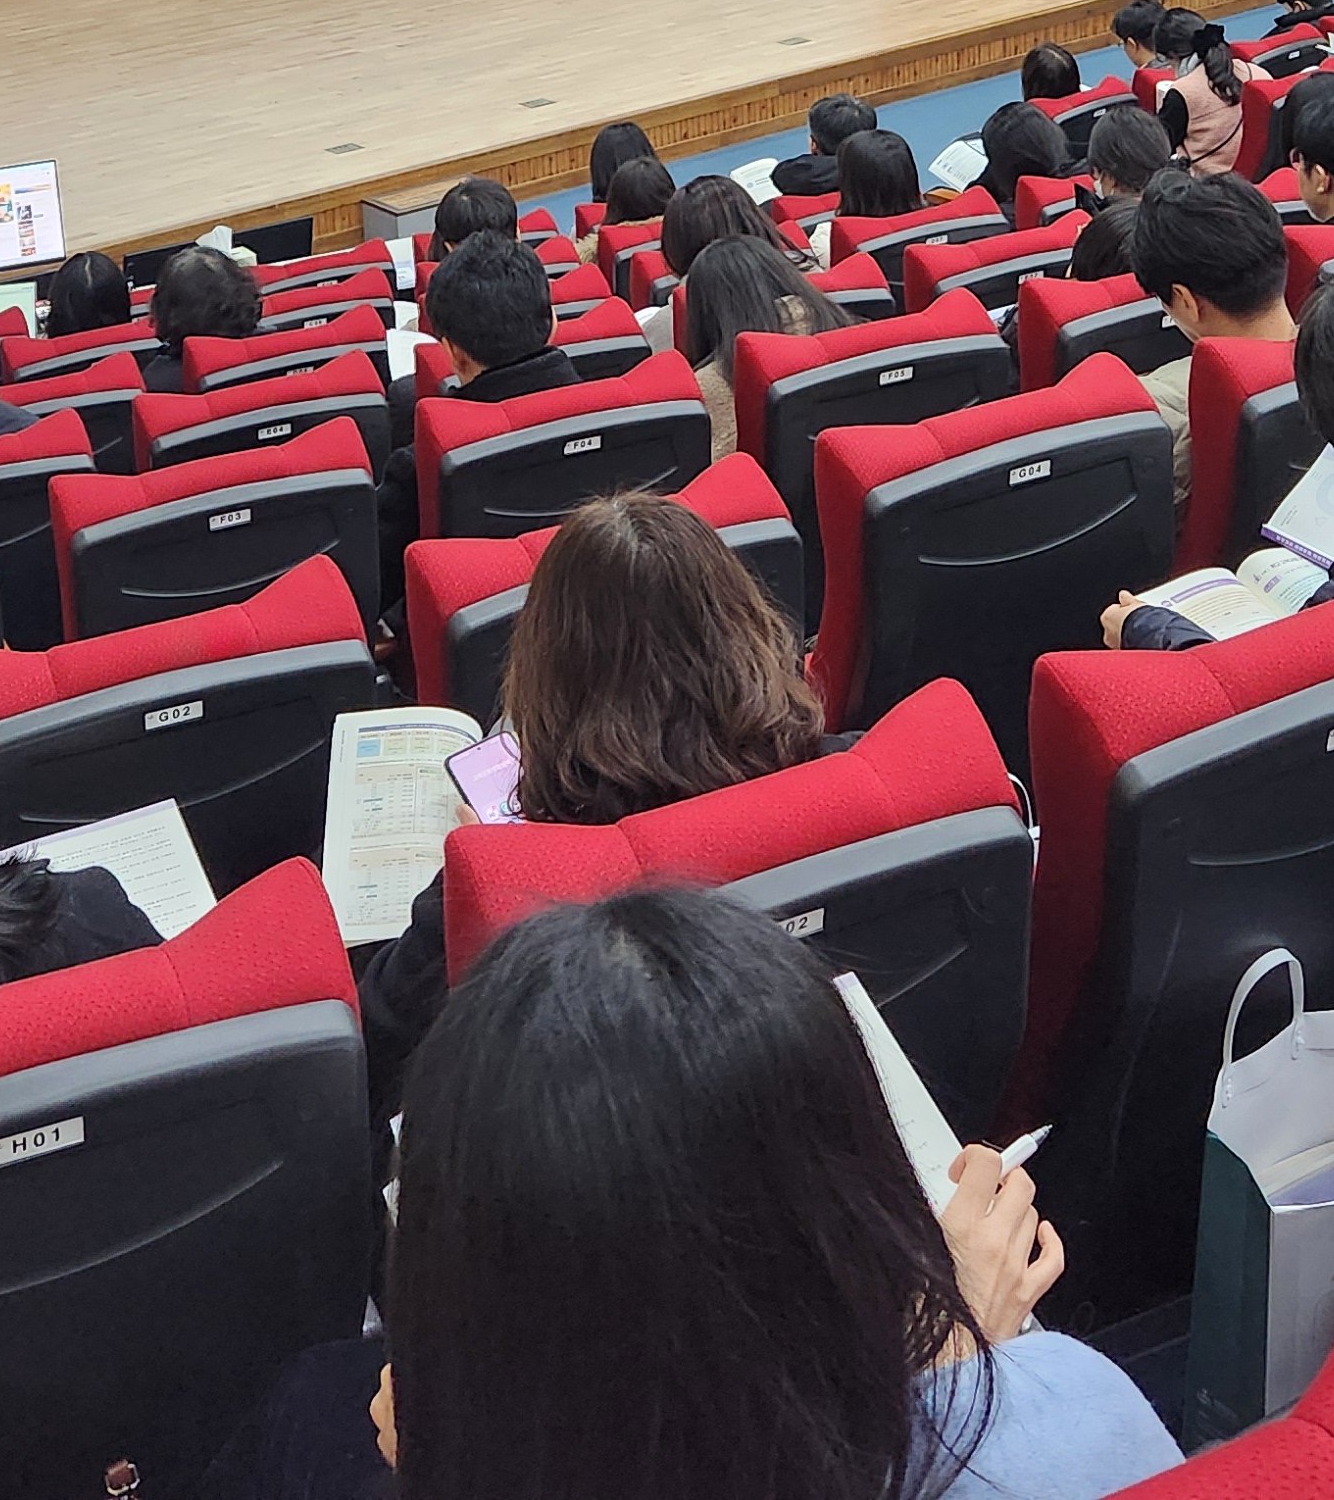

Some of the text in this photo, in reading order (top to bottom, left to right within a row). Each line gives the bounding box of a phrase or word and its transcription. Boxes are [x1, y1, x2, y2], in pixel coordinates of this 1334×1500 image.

[888, 370, 905, 379] F05
[574, 440, 592, 449] F04
[1019, 468, 1042, 478] G04
[220, 512, 241, 524] F03
[159, 706, 191, 722] G02
[11, 1127, 62, 1154] H01
